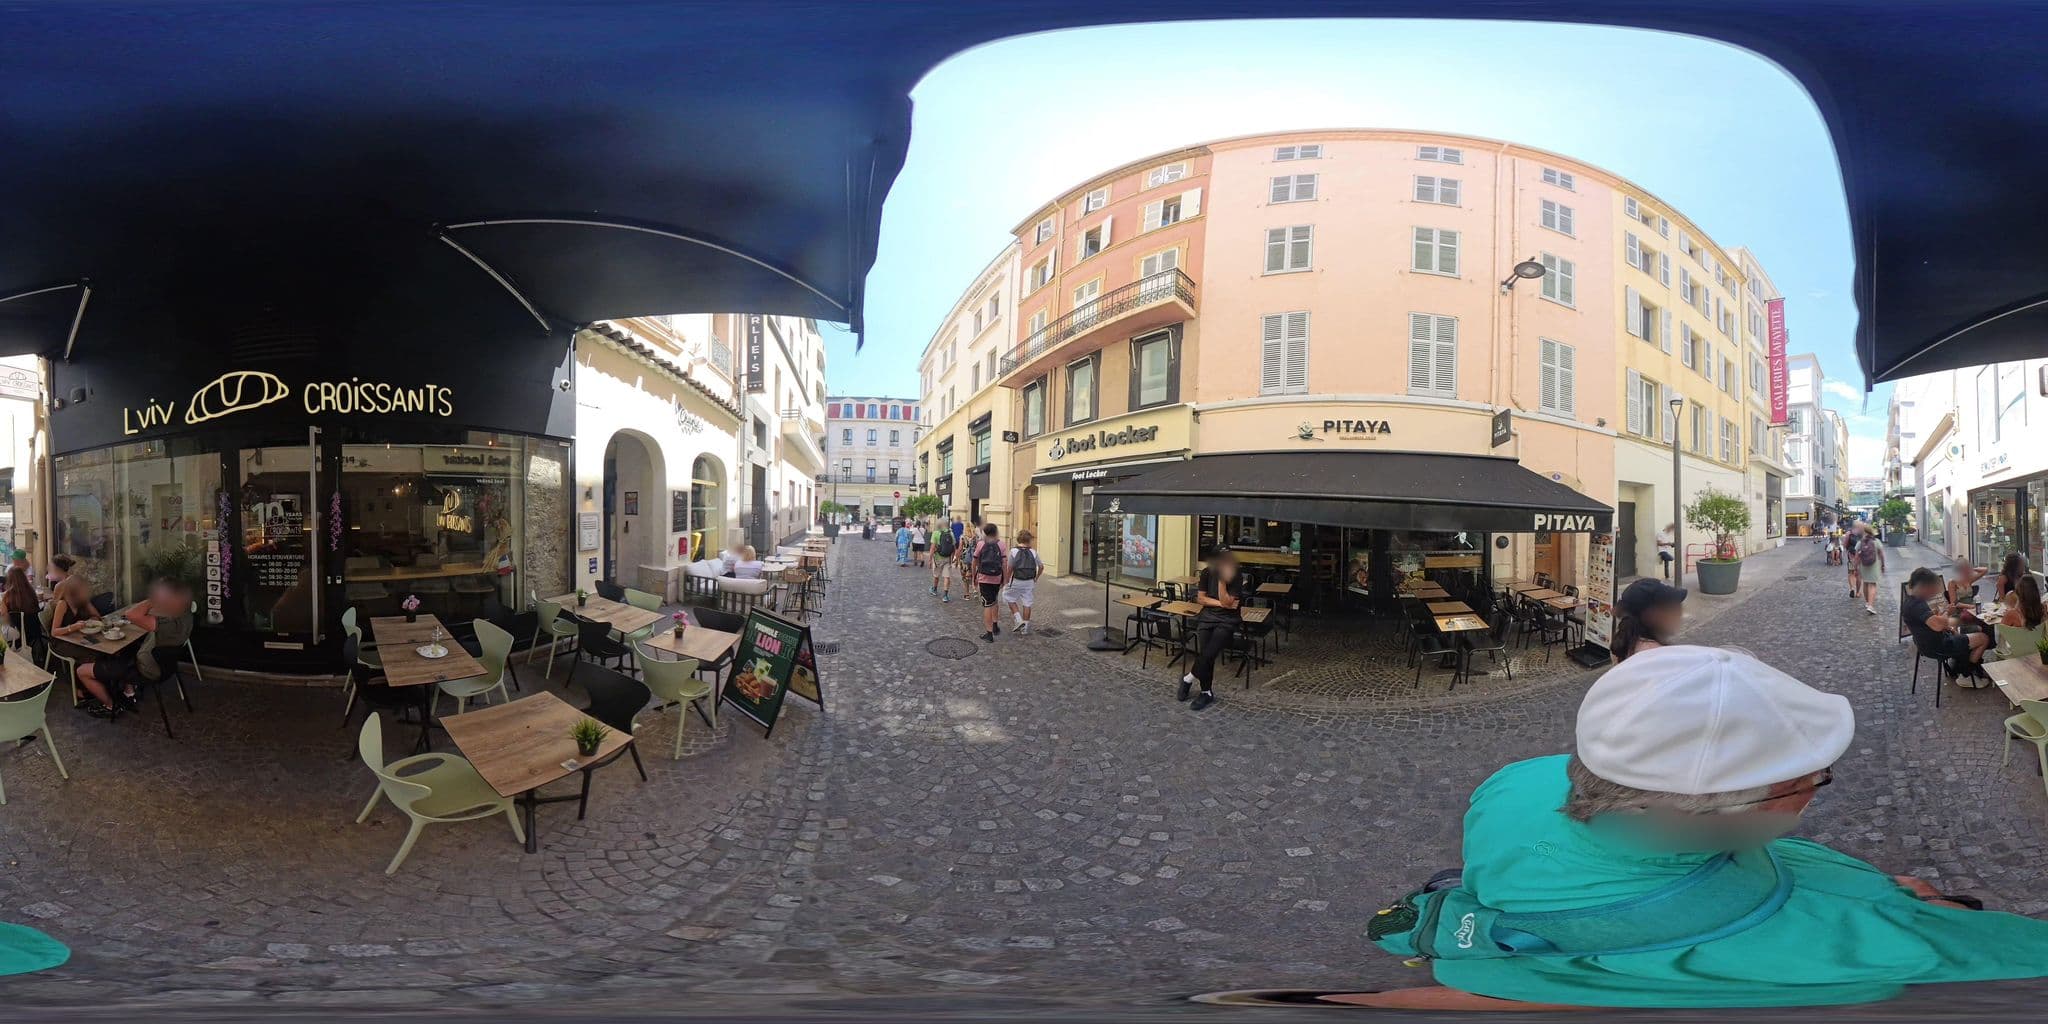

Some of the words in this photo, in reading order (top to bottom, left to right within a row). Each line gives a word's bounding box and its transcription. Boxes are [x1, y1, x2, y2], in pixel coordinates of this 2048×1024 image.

[751, 314, 760, 373] RLIE'S
[1771, 307, 1782, 357] LAFAYETTE
[1773, 359, 1783, 410] GALERIES
[1066, 434, 1096, 454] Foot
[1098, 424, 1158, 448] Locker
[1323, 420, 1392, 434] PITAYA
[1072, 472, 1085, 480] Foot
[1085, 470, 1108, 479] Locker
[1534, 513, 1596, 531] PITAYA
